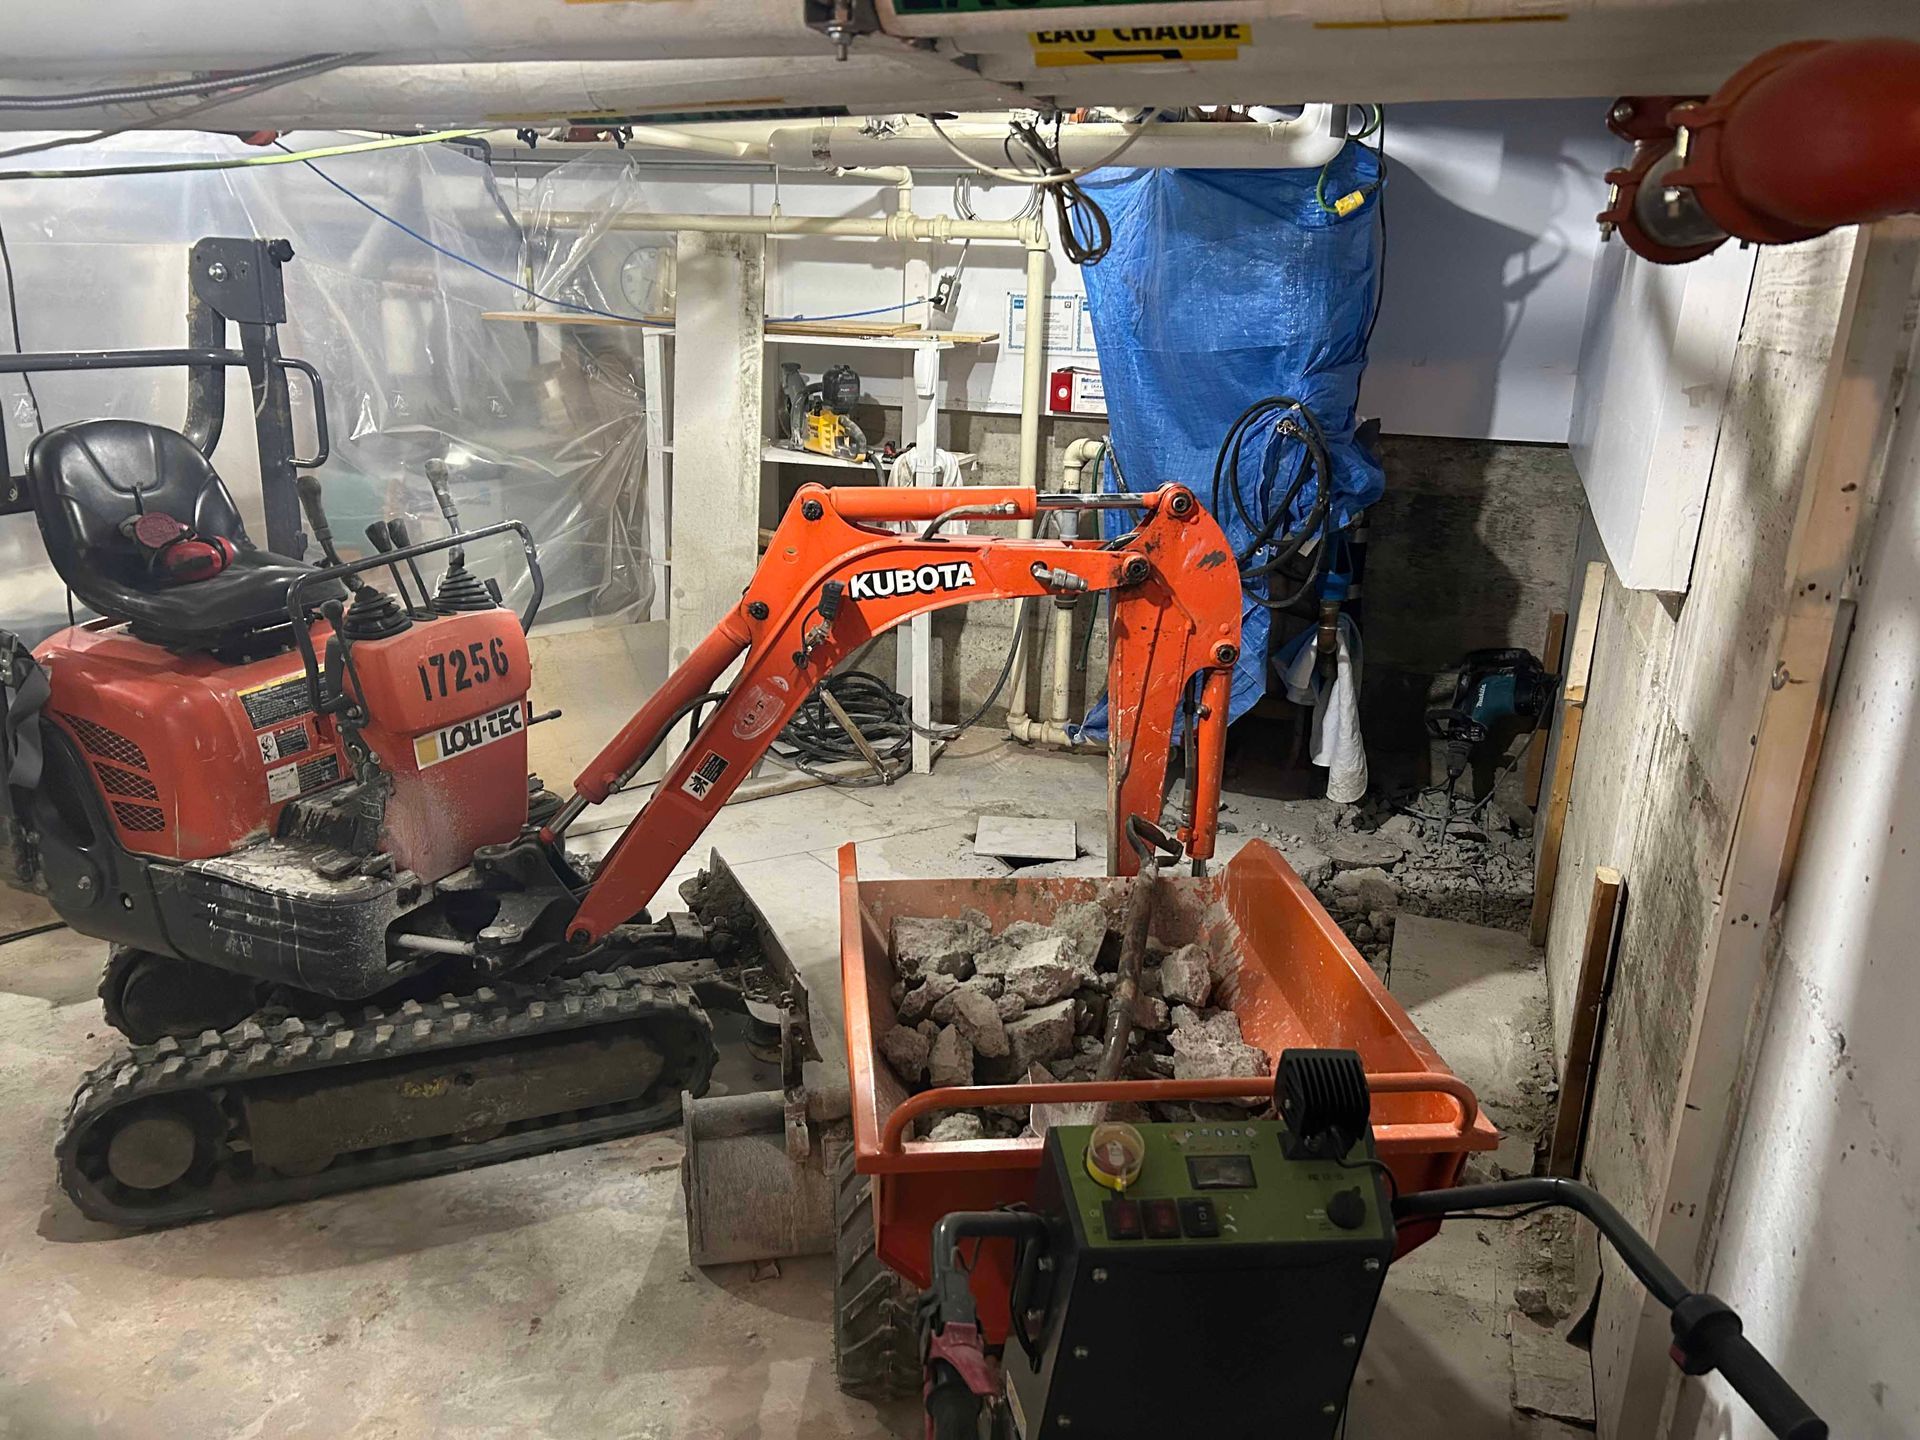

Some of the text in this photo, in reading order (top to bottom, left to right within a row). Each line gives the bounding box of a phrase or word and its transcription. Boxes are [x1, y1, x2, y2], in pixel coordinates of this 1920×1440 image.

[1036, 23, 1240, 45] EAU CHAUDE
[850, 562, 976, 599] KUBOTA
[418, 637, 509, 702] 17256
